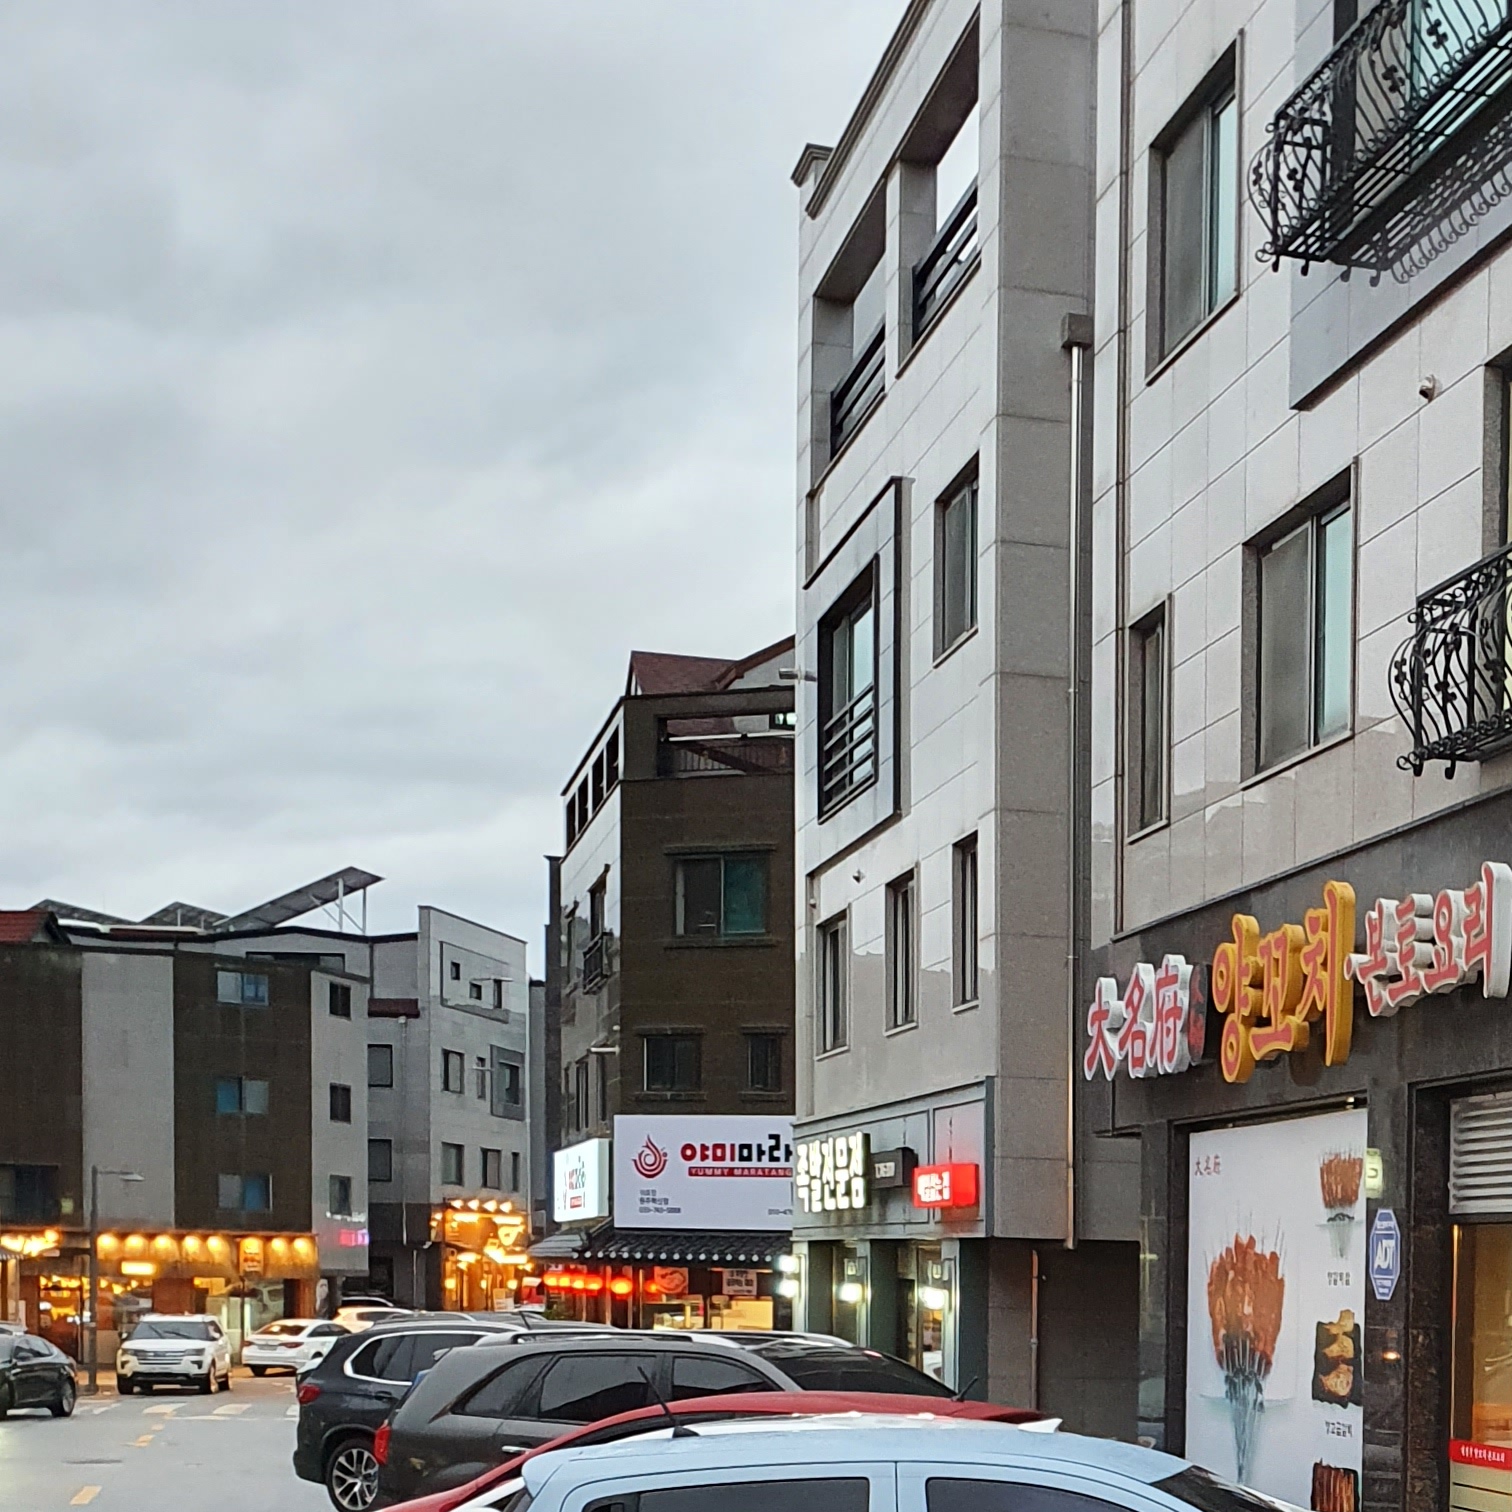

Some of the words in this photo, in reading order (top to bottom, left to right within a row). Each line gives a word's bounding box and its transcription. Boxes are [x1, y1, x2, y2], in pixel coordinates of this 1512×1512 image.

[1084, 954, 1197, 1082] 大名府
[1212, 880, 1354, 1083] 양꼬치
[690, 1167, 729, 1177] YUMMY
[733, 1167, 793, 1177] MARATANG
[1374, 1239, 1396, 1271] ADT
